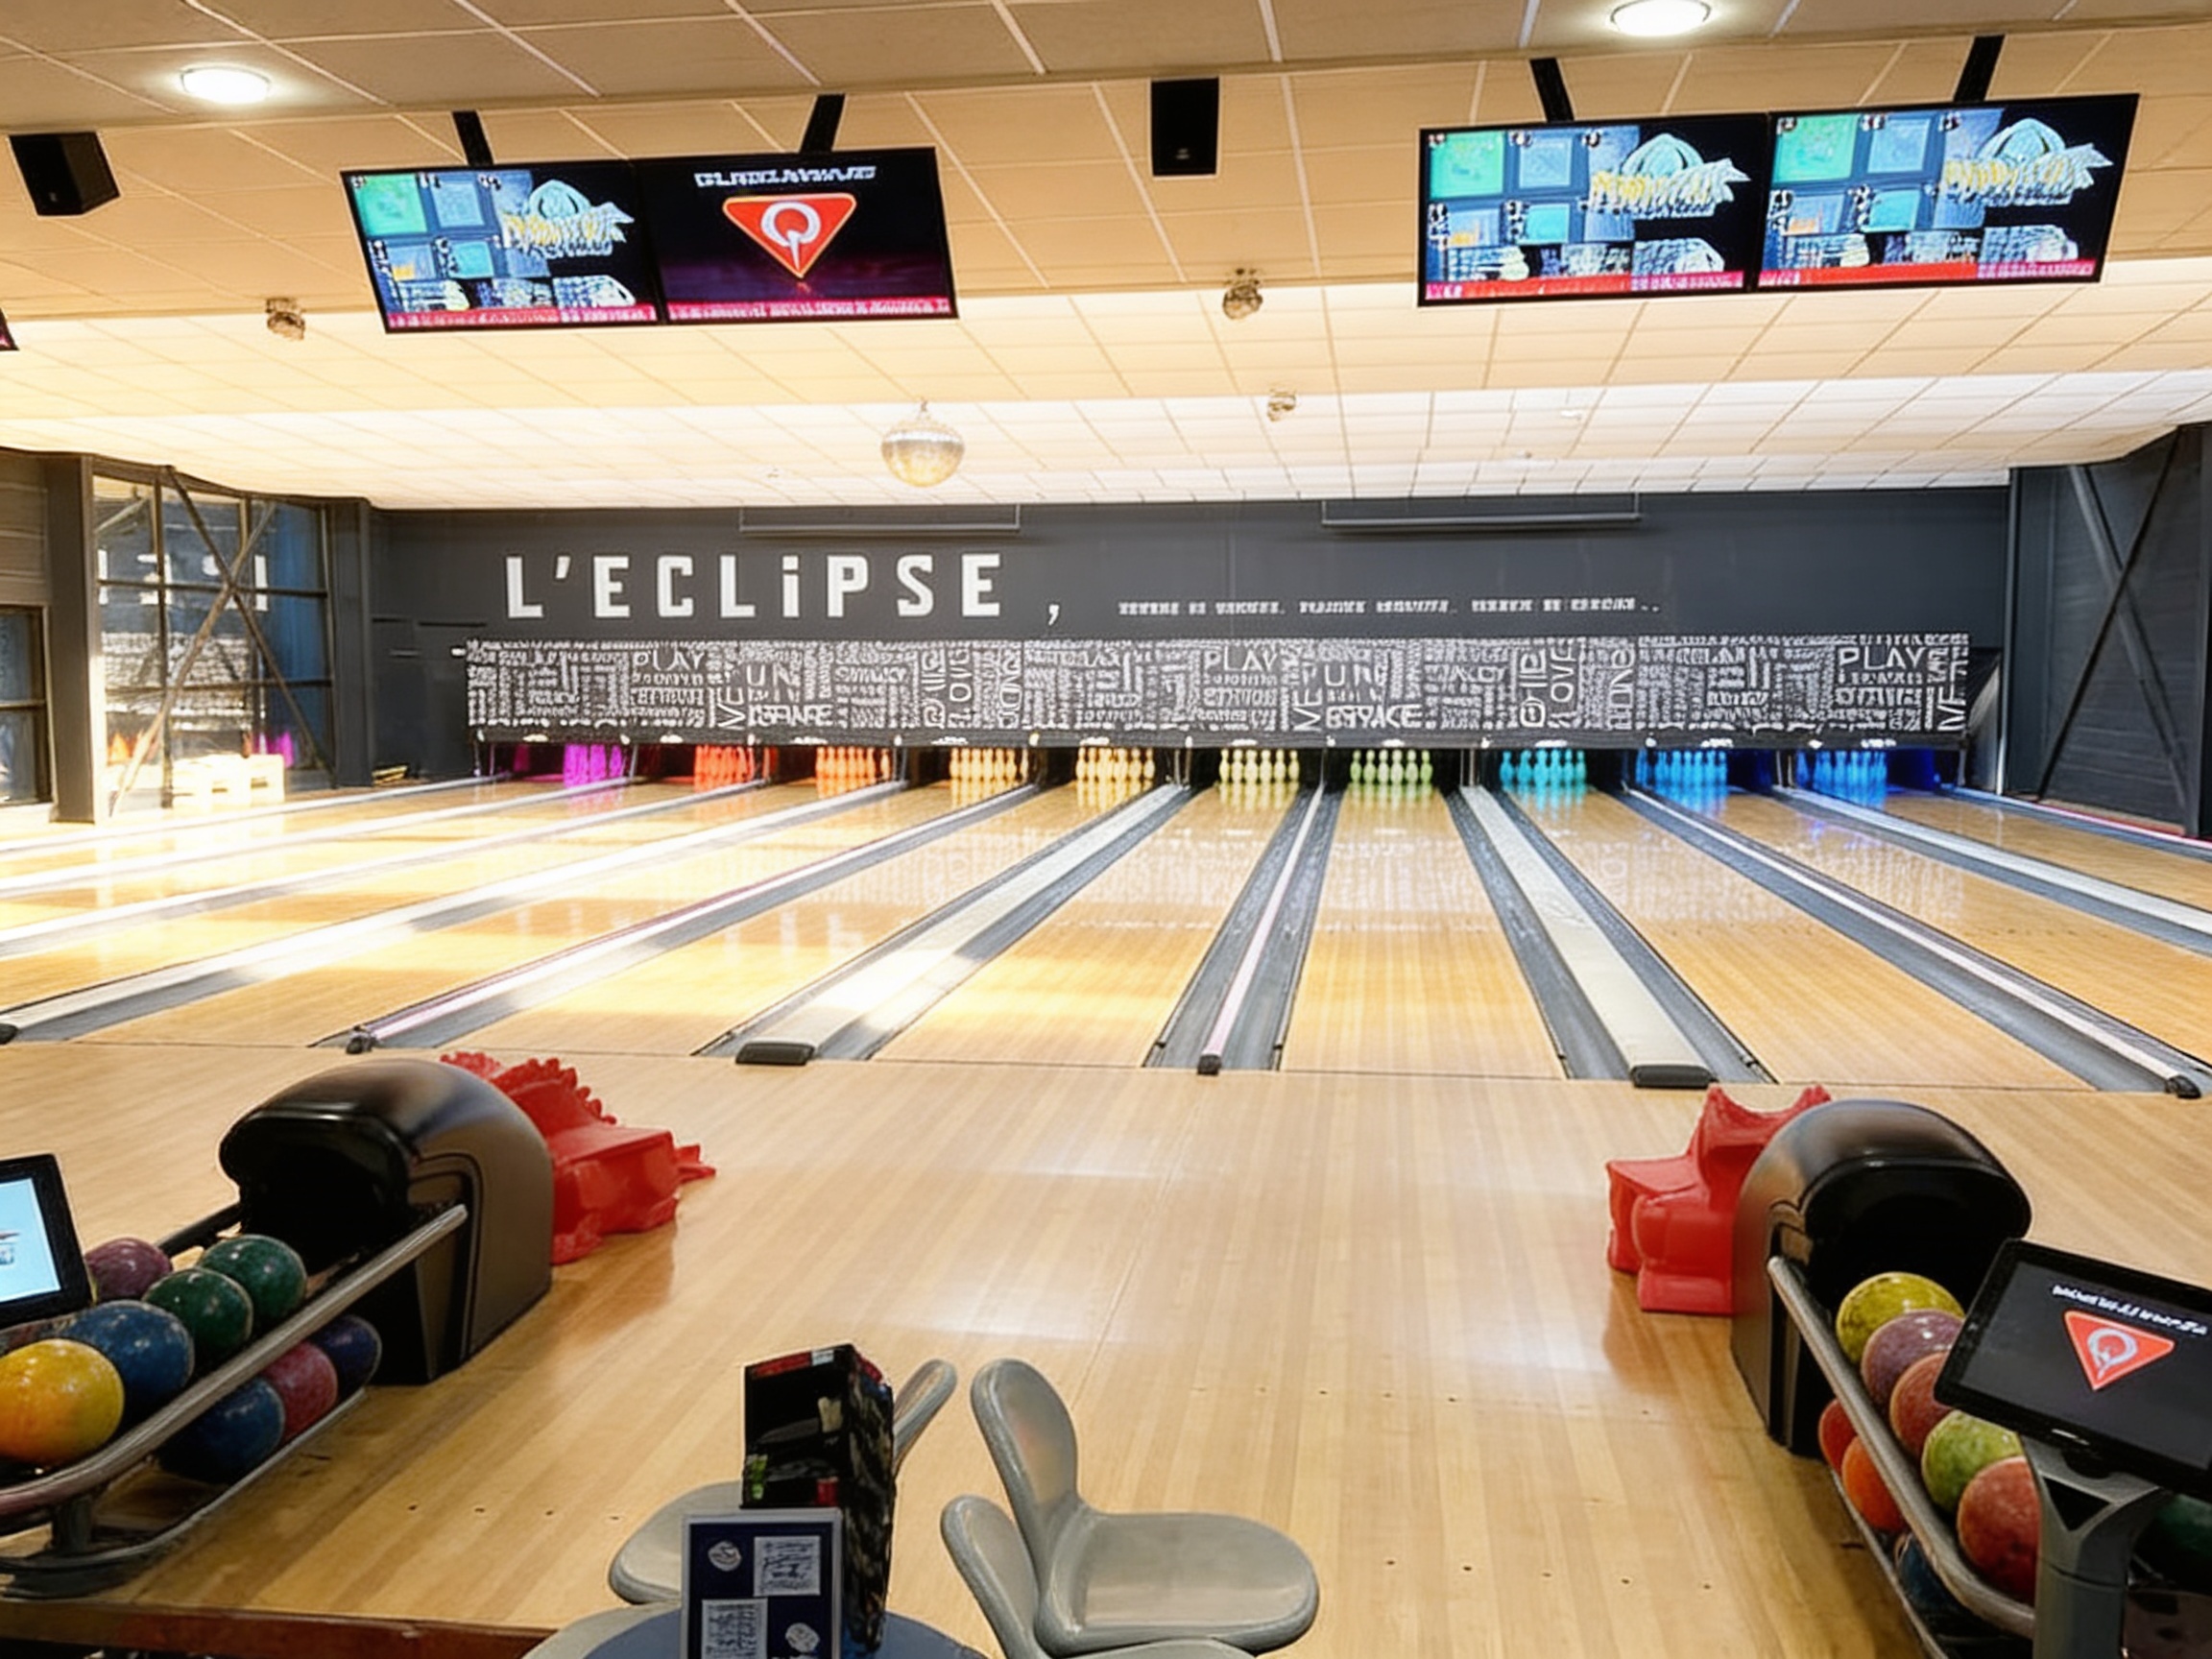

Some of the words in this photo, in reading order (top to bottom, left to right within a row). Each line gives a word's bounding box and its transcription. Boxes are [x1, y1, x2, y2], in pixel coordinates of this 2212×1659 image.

[632, 650, 706, 672] PLAY
[1204, 645, 1278, 672] PLAY
[1838, 645, 1926, 671] PLAY
